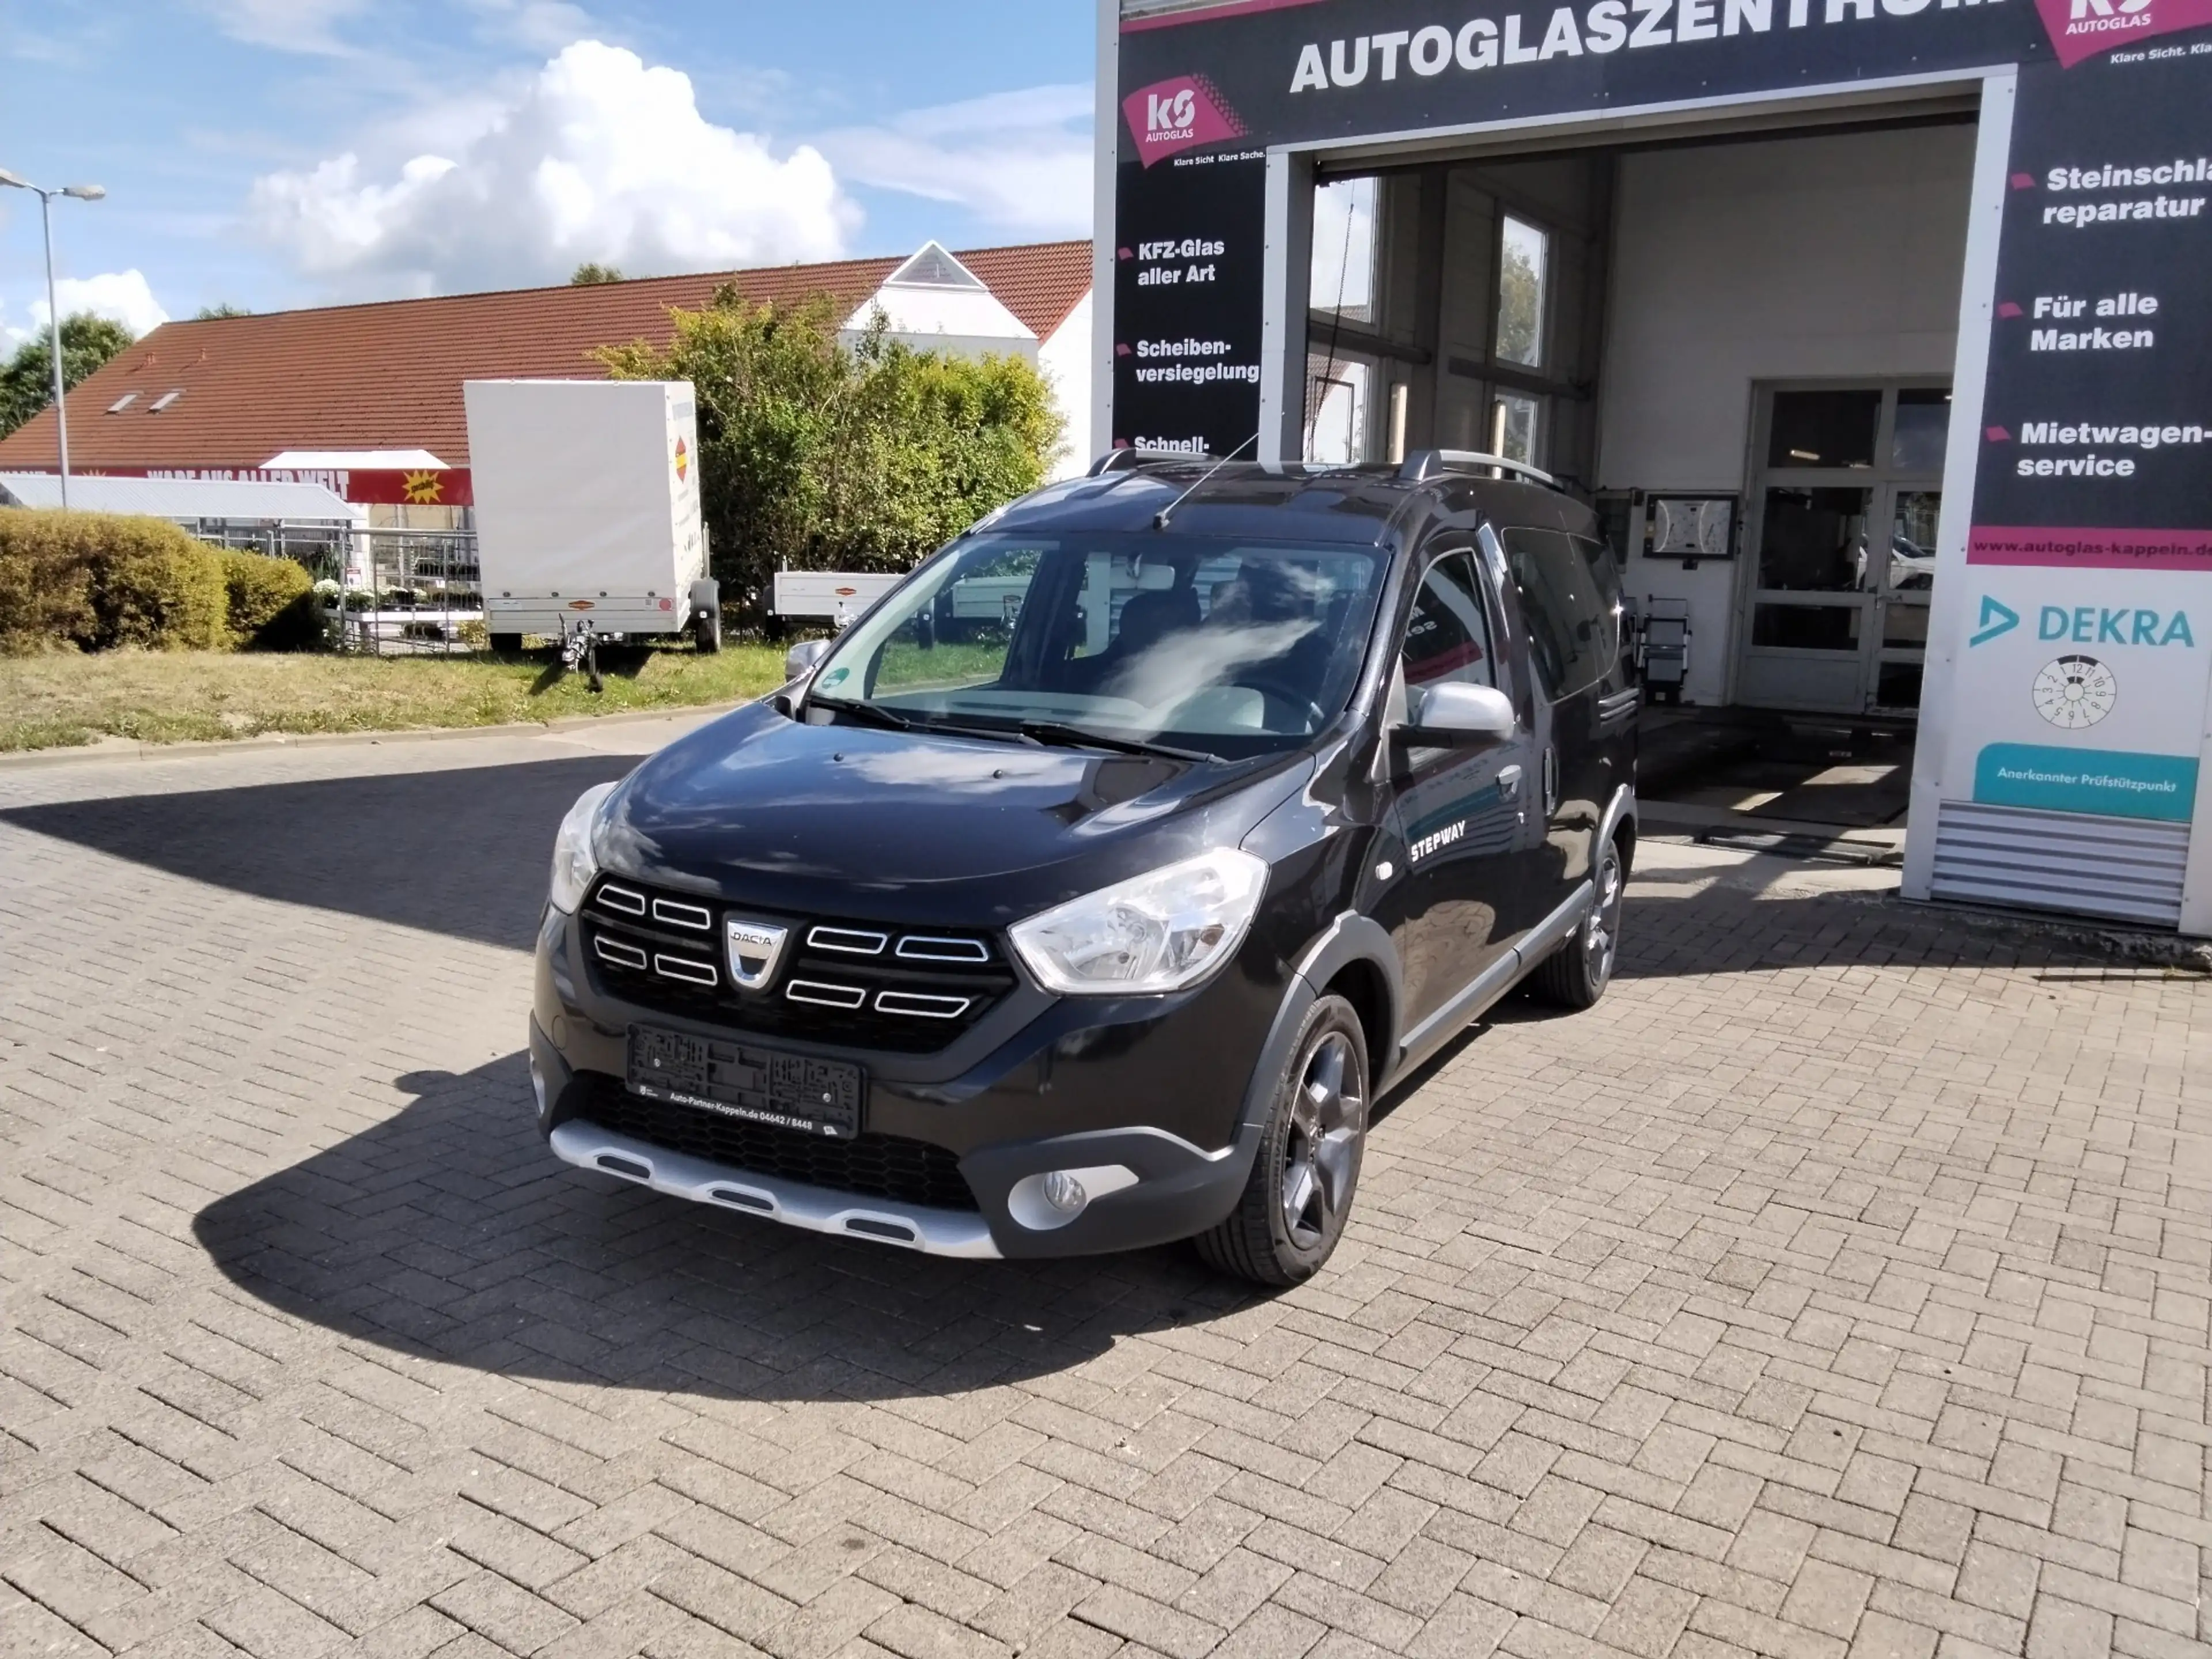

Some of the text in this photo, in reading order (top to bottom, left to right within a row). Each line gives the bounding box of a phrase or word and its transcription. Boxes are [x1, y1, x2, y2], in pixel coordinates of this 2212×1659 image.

[2065, 13, 2152, 35] AUTOGLAS
[2110, 52, 2145, 64] Klare
[2148, 47, 2186, 60] Sicht.
[1145, 128, 1194, 142] AUTOGLAS
[1173, 158, 1194, 166] Klare
[1218, 153, 1238, 162] Klare
[1240, 150, 1266, 160] Sache.
[2043, 196, 2205, 228] reparatur
[1138, 238, 1225, 260] KFZ-Glas
[1138, 264, 1215, 285] aller Art
[2033, 293, 2158, 319] Für alle
[1136, 338, 1232, 357] Scheiben-
[2030, 327, 2153, 351] Marken
[1136, 363, 1259, 384] versiegelung
[1134, 436, 1210, 453] Schnell-
[2021, 422, 2212, 449] Mietwagen-
[2017, 453, 2135, 476] service
[2038, 605, 2195, 647] DEKRA
[2072, 664, 2083, 673] 12
[2093, 676, 2105, 688] 10
[1997, 767, 2176, 793] Anerkannter Prüfstützpunkt
[1411, 820, 1465, 862] STEPWAY
[734, 932, 772, 946] DACIA
[670, 1092, 757, 1119] Auto-Partner-Kappeln.de
[759, 1112, 786, 1124] 04642
